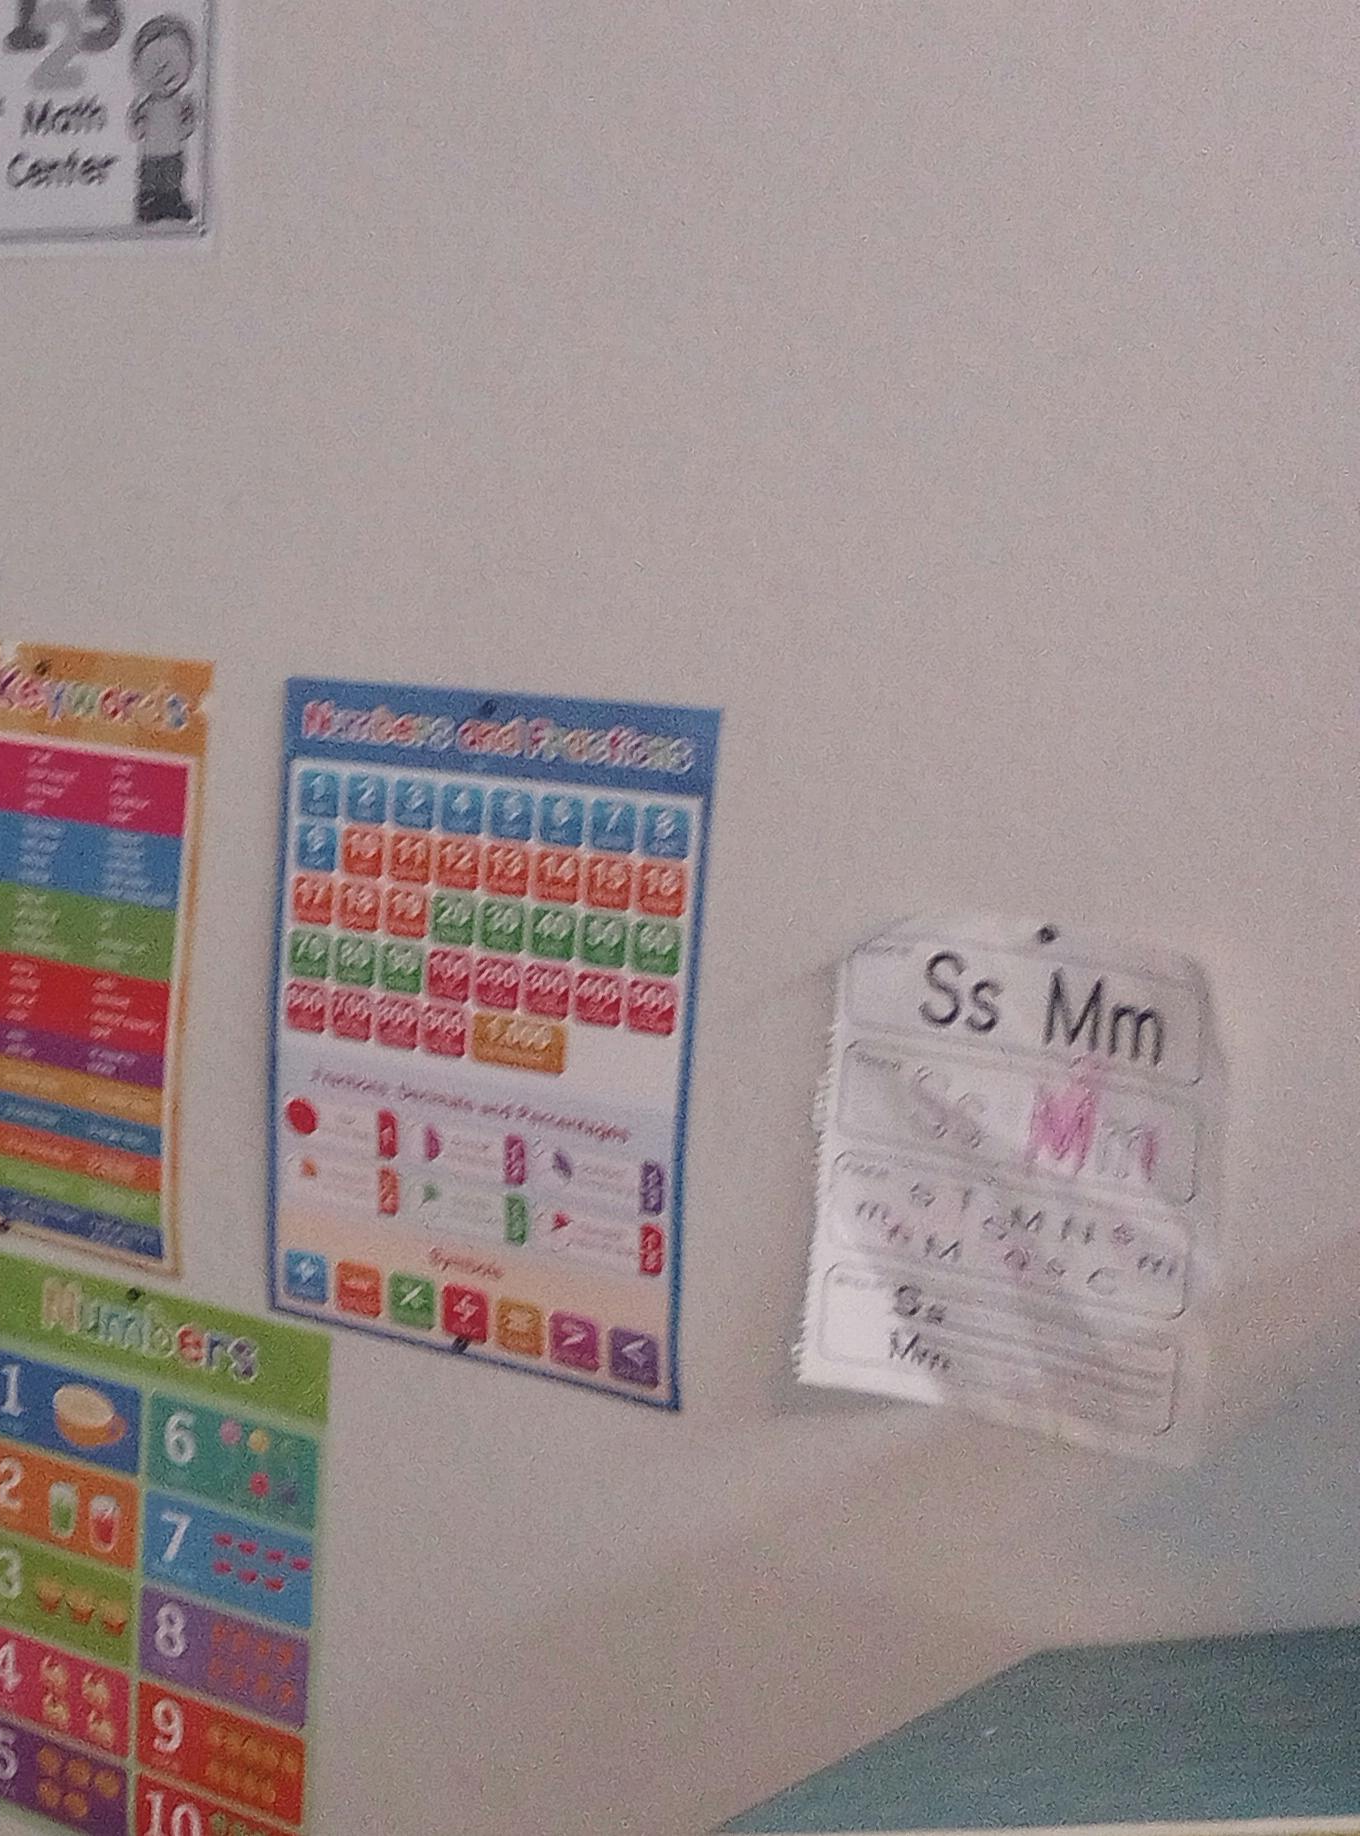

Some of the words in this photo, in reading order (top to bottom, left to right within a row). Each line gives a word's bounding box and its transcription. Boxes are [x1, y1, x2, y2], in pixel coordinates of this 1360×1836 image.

[21, 94, 108, 136] Math
[5, 149, 120, 188] Center
[301, 700, 456, 751] Numbers
[456, 714, 526, 757] and
[525, 716, 695, 776] Fractions
[310, 775, 326, 800] 1
[357, 776, 376, 806] 2
[405, 780, 425, 810] 3
[452, 789, 471, 814] 4
[605, 804, 623, 832] 7
[655, 811, 674, 839] 8
[307, 826, 326, 853] 9
[349, 830, 379, 858] 10
[395, 837, 427, 865] 11
[443, 842, 475, 870] 12
[493, 848, 523, 877] 13
[540, 855, 575, 884] 14
[592, 861, 627, 890] 15
[298, 877, 328, 905] 17
[345, 884, 375, 914] 18
[392, 890, 422, 919] 19
[438, 896, 472, 926] 20
[486, 904, 519, 934] 30
[535, 910, 572, 940] 40
[587, 919, 623, 948] 50
[918, 950, 1004, 1034] Ss
[1043, 967, 1166, 1067] Mm
[911, 1063, 986, 1150] Ss
[1026, 1084, 1159, 1182] Mm
[40, 1276, 259, 1384] Numbers
[0, 1364, 26, 1417] 1
[164, 1410, 197, 1466] 6
[159, 1510, 193, 1563] 7
[154, 1602, 187, 1659] 8
[151, 1697, 185, 1754] 9
[144, 1789, 203, 1836] 10
